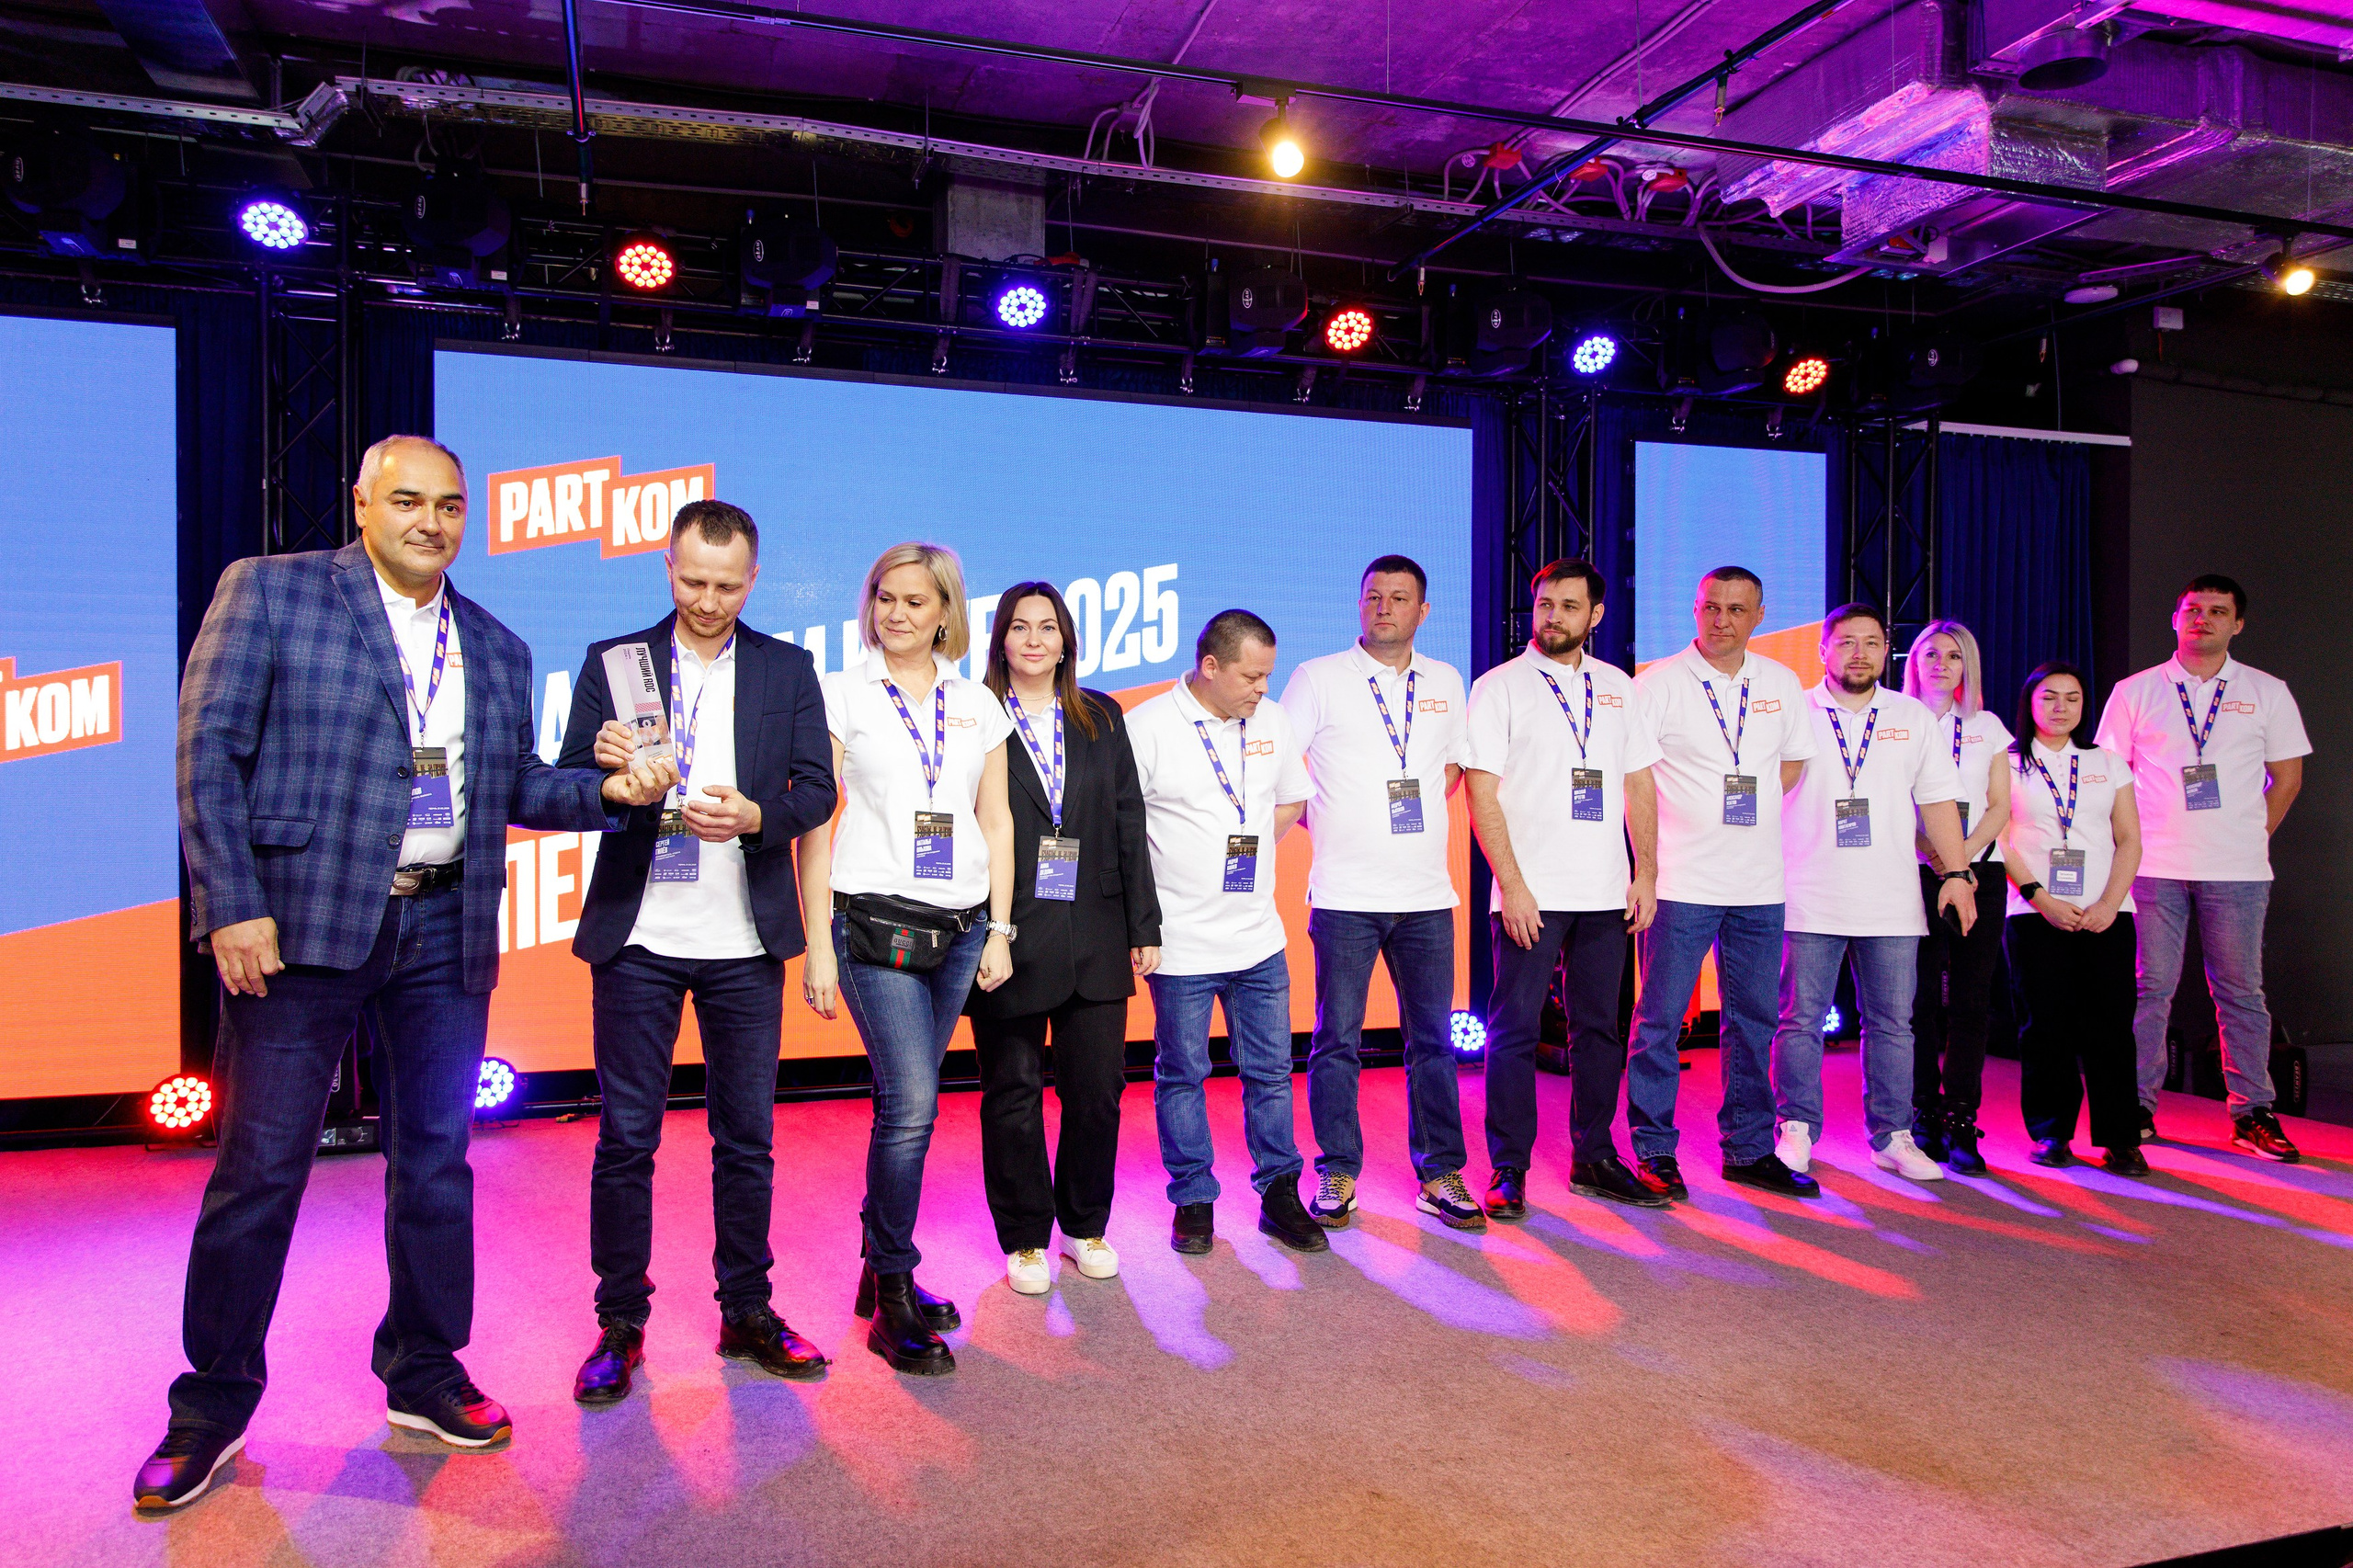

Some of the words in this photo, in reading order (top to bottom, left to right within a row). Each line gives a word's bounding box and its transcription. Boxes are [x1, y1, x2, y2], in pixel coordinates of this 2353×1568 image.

[500, 469, 610, 542] PART
[1063, 562, 1179, 679] 025
[635, 647, 654, 679] ЛУЧШИЙ
[6, 675, 109, 751] KOM
[1420, 700, 1435, 710] PART
